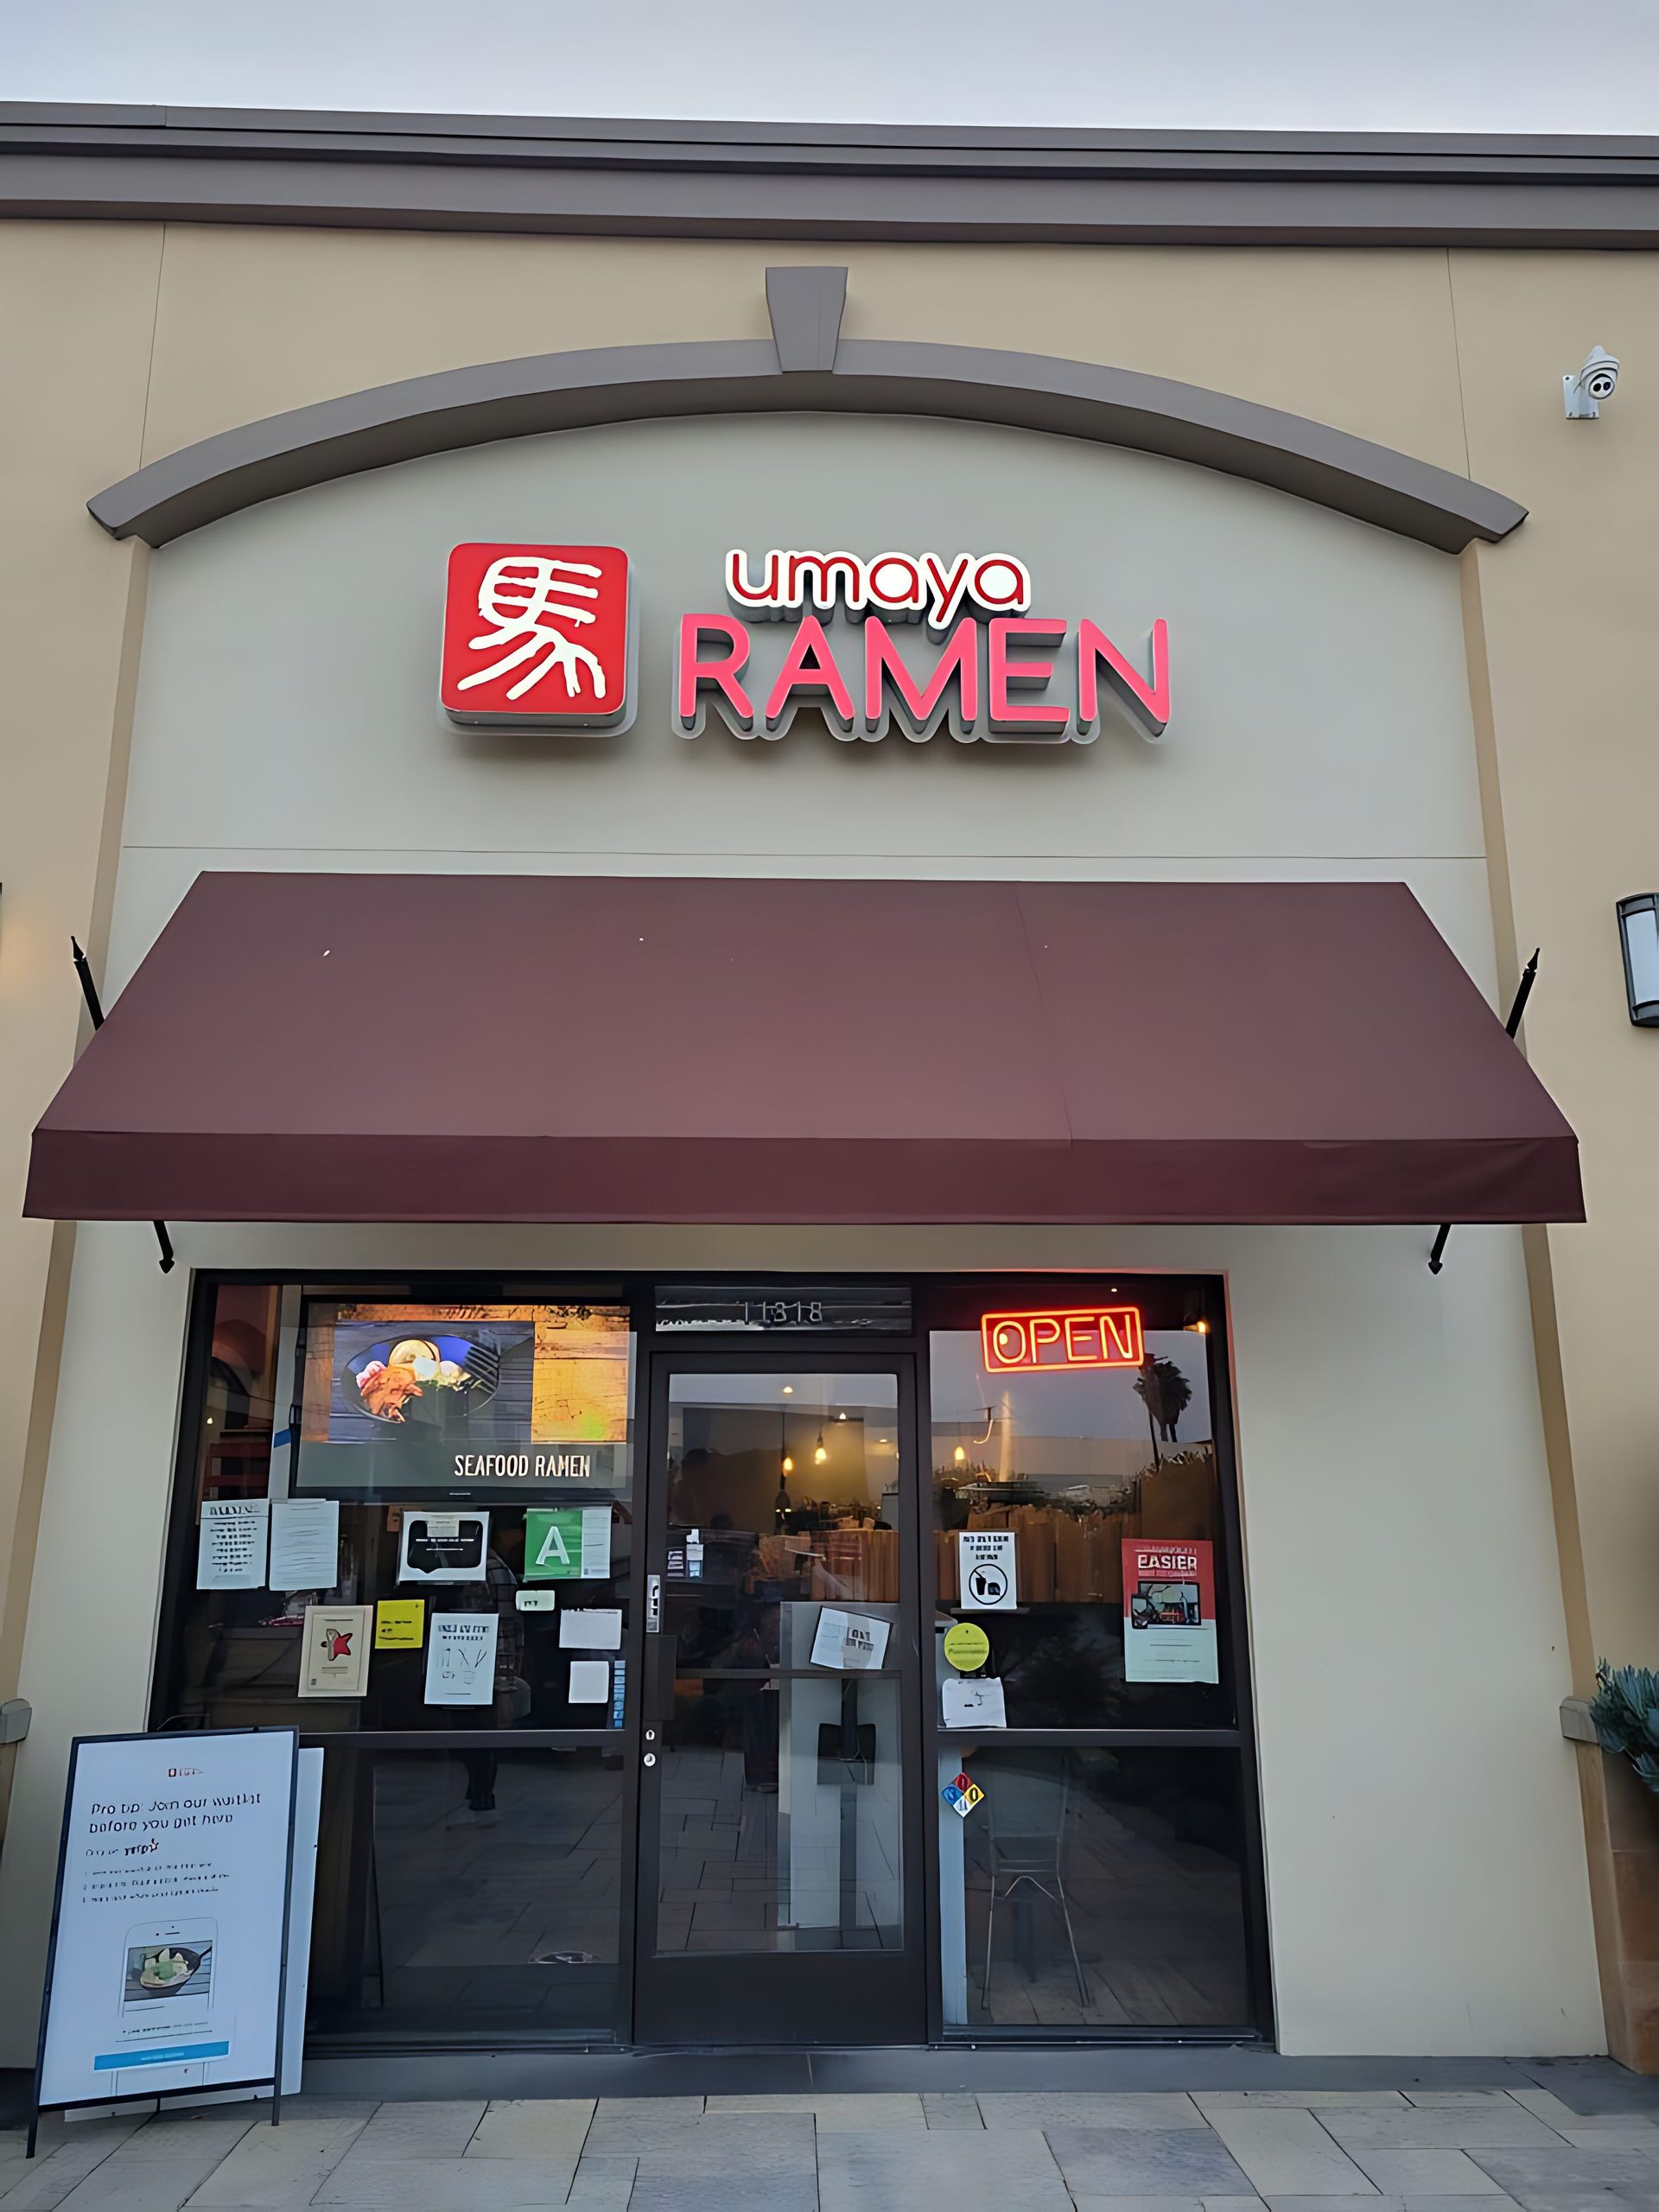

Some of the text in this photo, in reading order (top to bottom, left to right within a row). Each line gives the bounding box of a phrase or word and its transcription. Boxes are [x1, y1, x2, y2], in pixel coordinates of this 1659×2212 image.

[730, 551, 1026, 625] umaya
[456, 555, 607, 701] 馬
[678, 613, 1173, 725] RAMEN
[992, 1313, 1134, 1364] OPEN
[454, 1454, 591, 1478] SEAFOOD RAMEN
[535, 1525, 570, 1566] A
